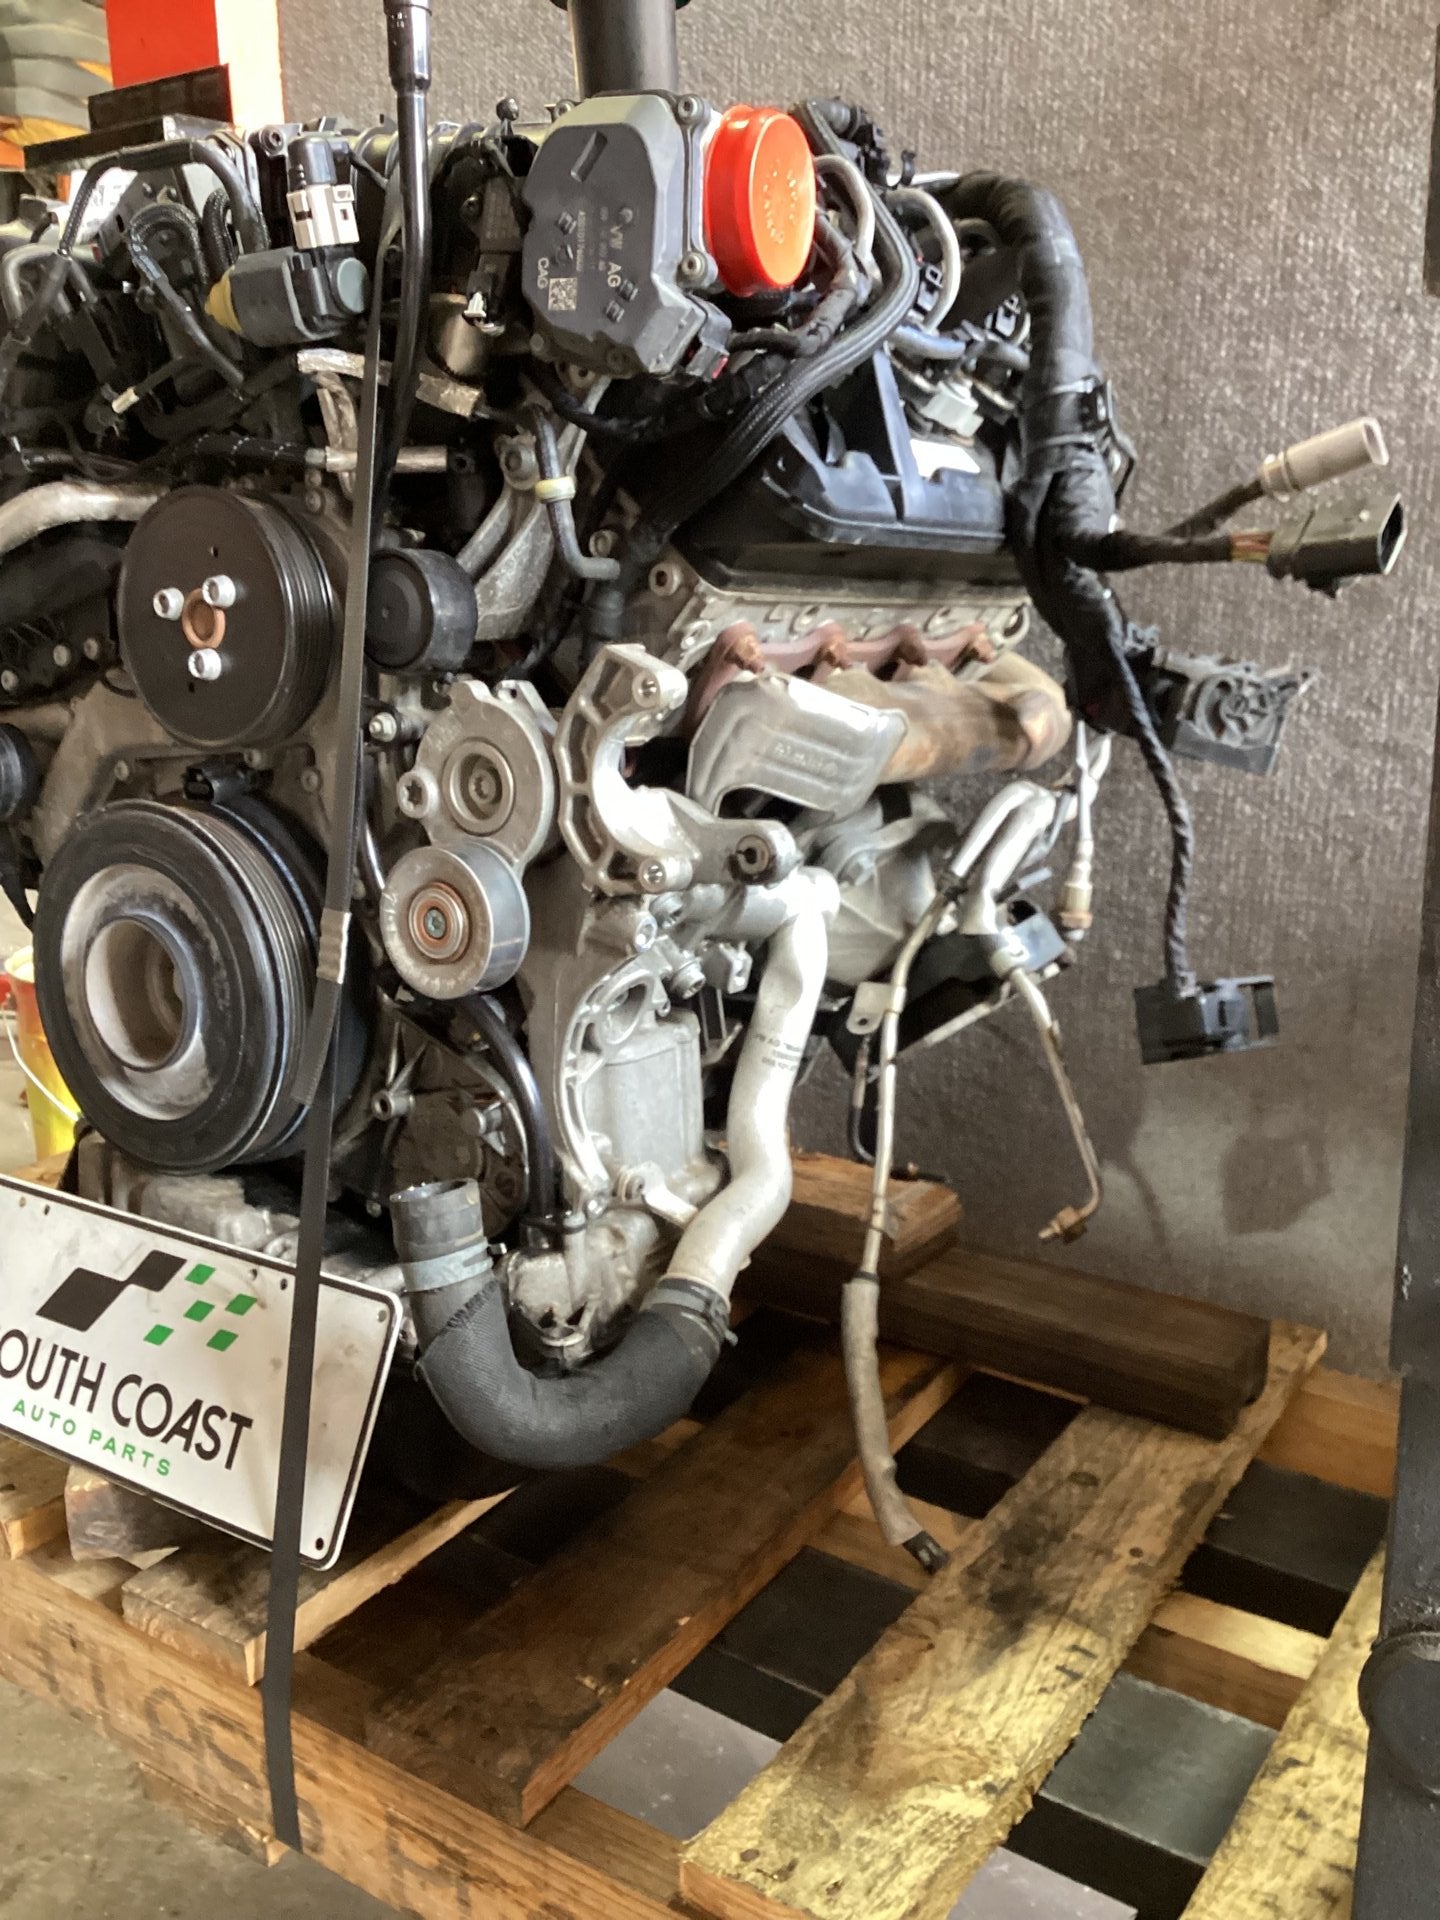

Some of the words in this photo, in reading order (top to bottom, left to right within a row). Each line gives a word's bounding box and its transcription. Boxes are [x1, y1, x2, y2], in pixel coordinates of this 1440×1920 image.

[537, 257, 550, 290] CAG
[607, 261, 622, 288] AG
[0, 1329, 106, 1412] OUTH
[112, 1374, 254, 1470] COAST
[13, 1399, 76, 1436] AUTO
[89, 1429, 171, 1477] PARTS
